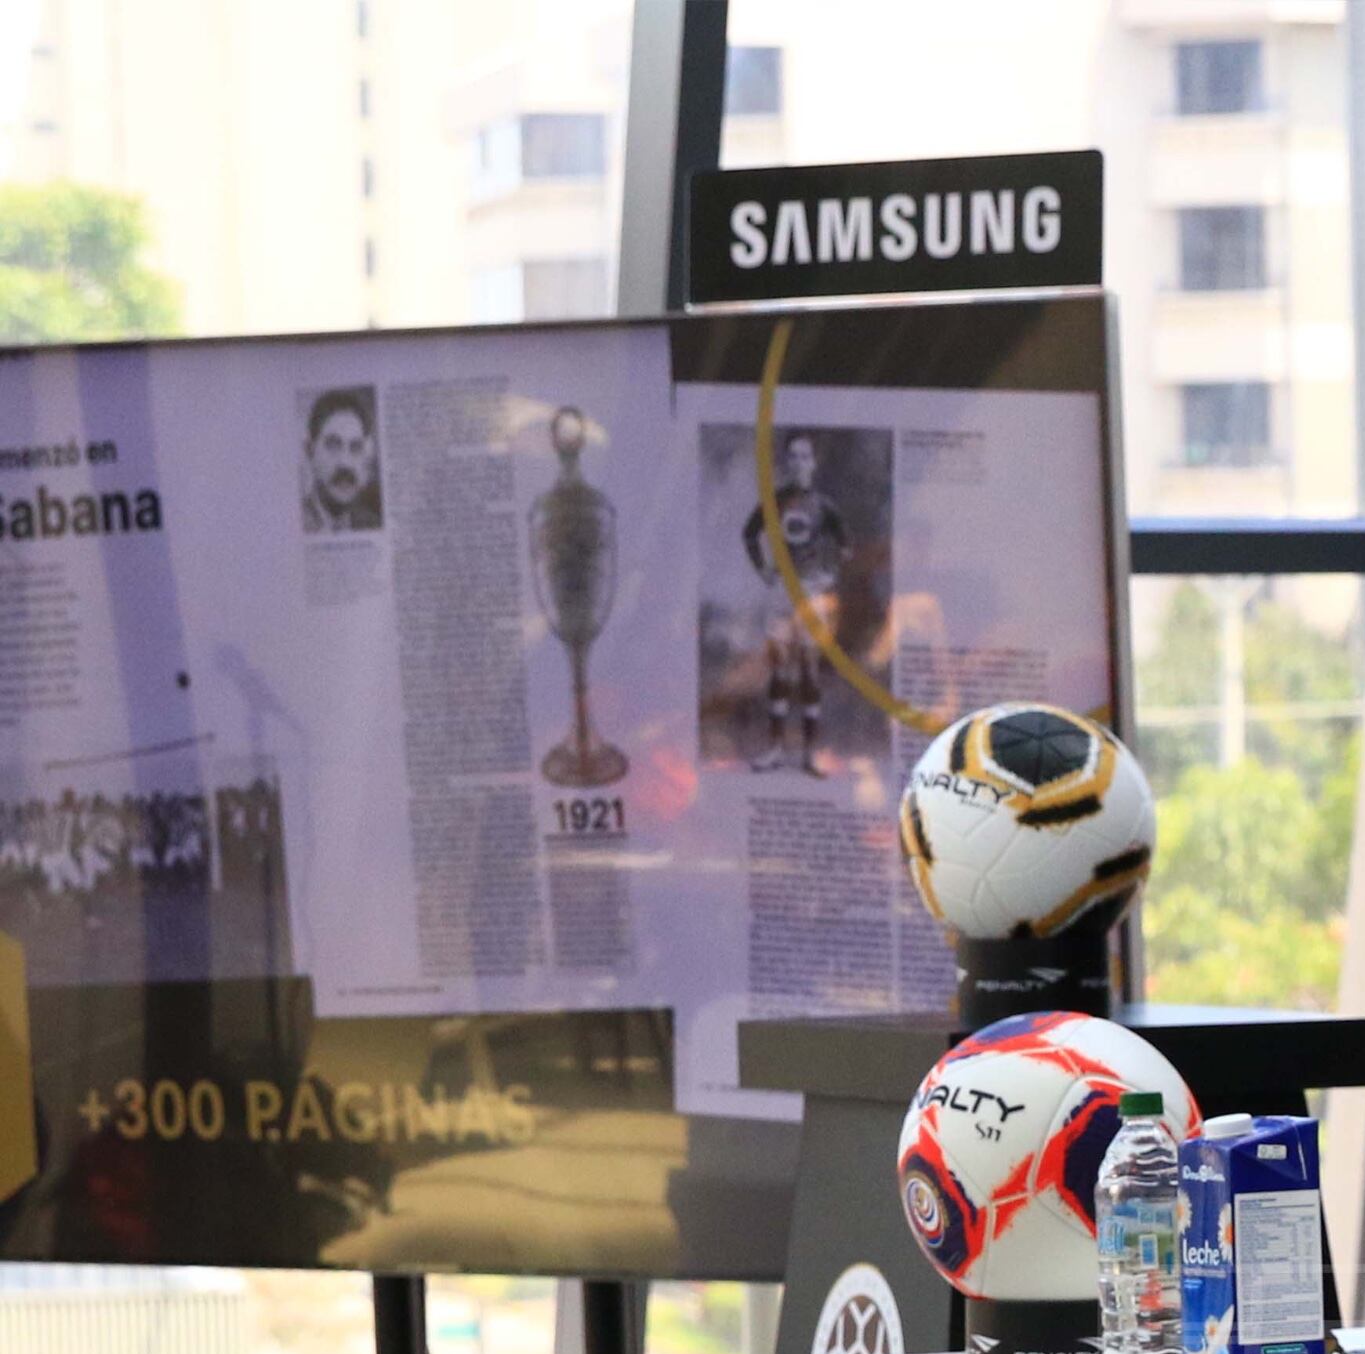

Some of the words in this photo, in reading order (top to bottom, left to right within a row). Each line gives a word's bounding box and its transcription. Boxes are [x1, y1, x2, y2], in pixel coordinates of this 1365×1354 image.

[730, 186, 1062, 268] SAMSUNG
[0, 484, 162, 541] abana
[915, 772, 1013, 804] NALTY
[553, 797, 626, 832] 1921
[77, 1079, 226, 1141] +300
[915, 1085, 1026, 1122] NALTY
[1182, 1239, 1220, 1267] leche
